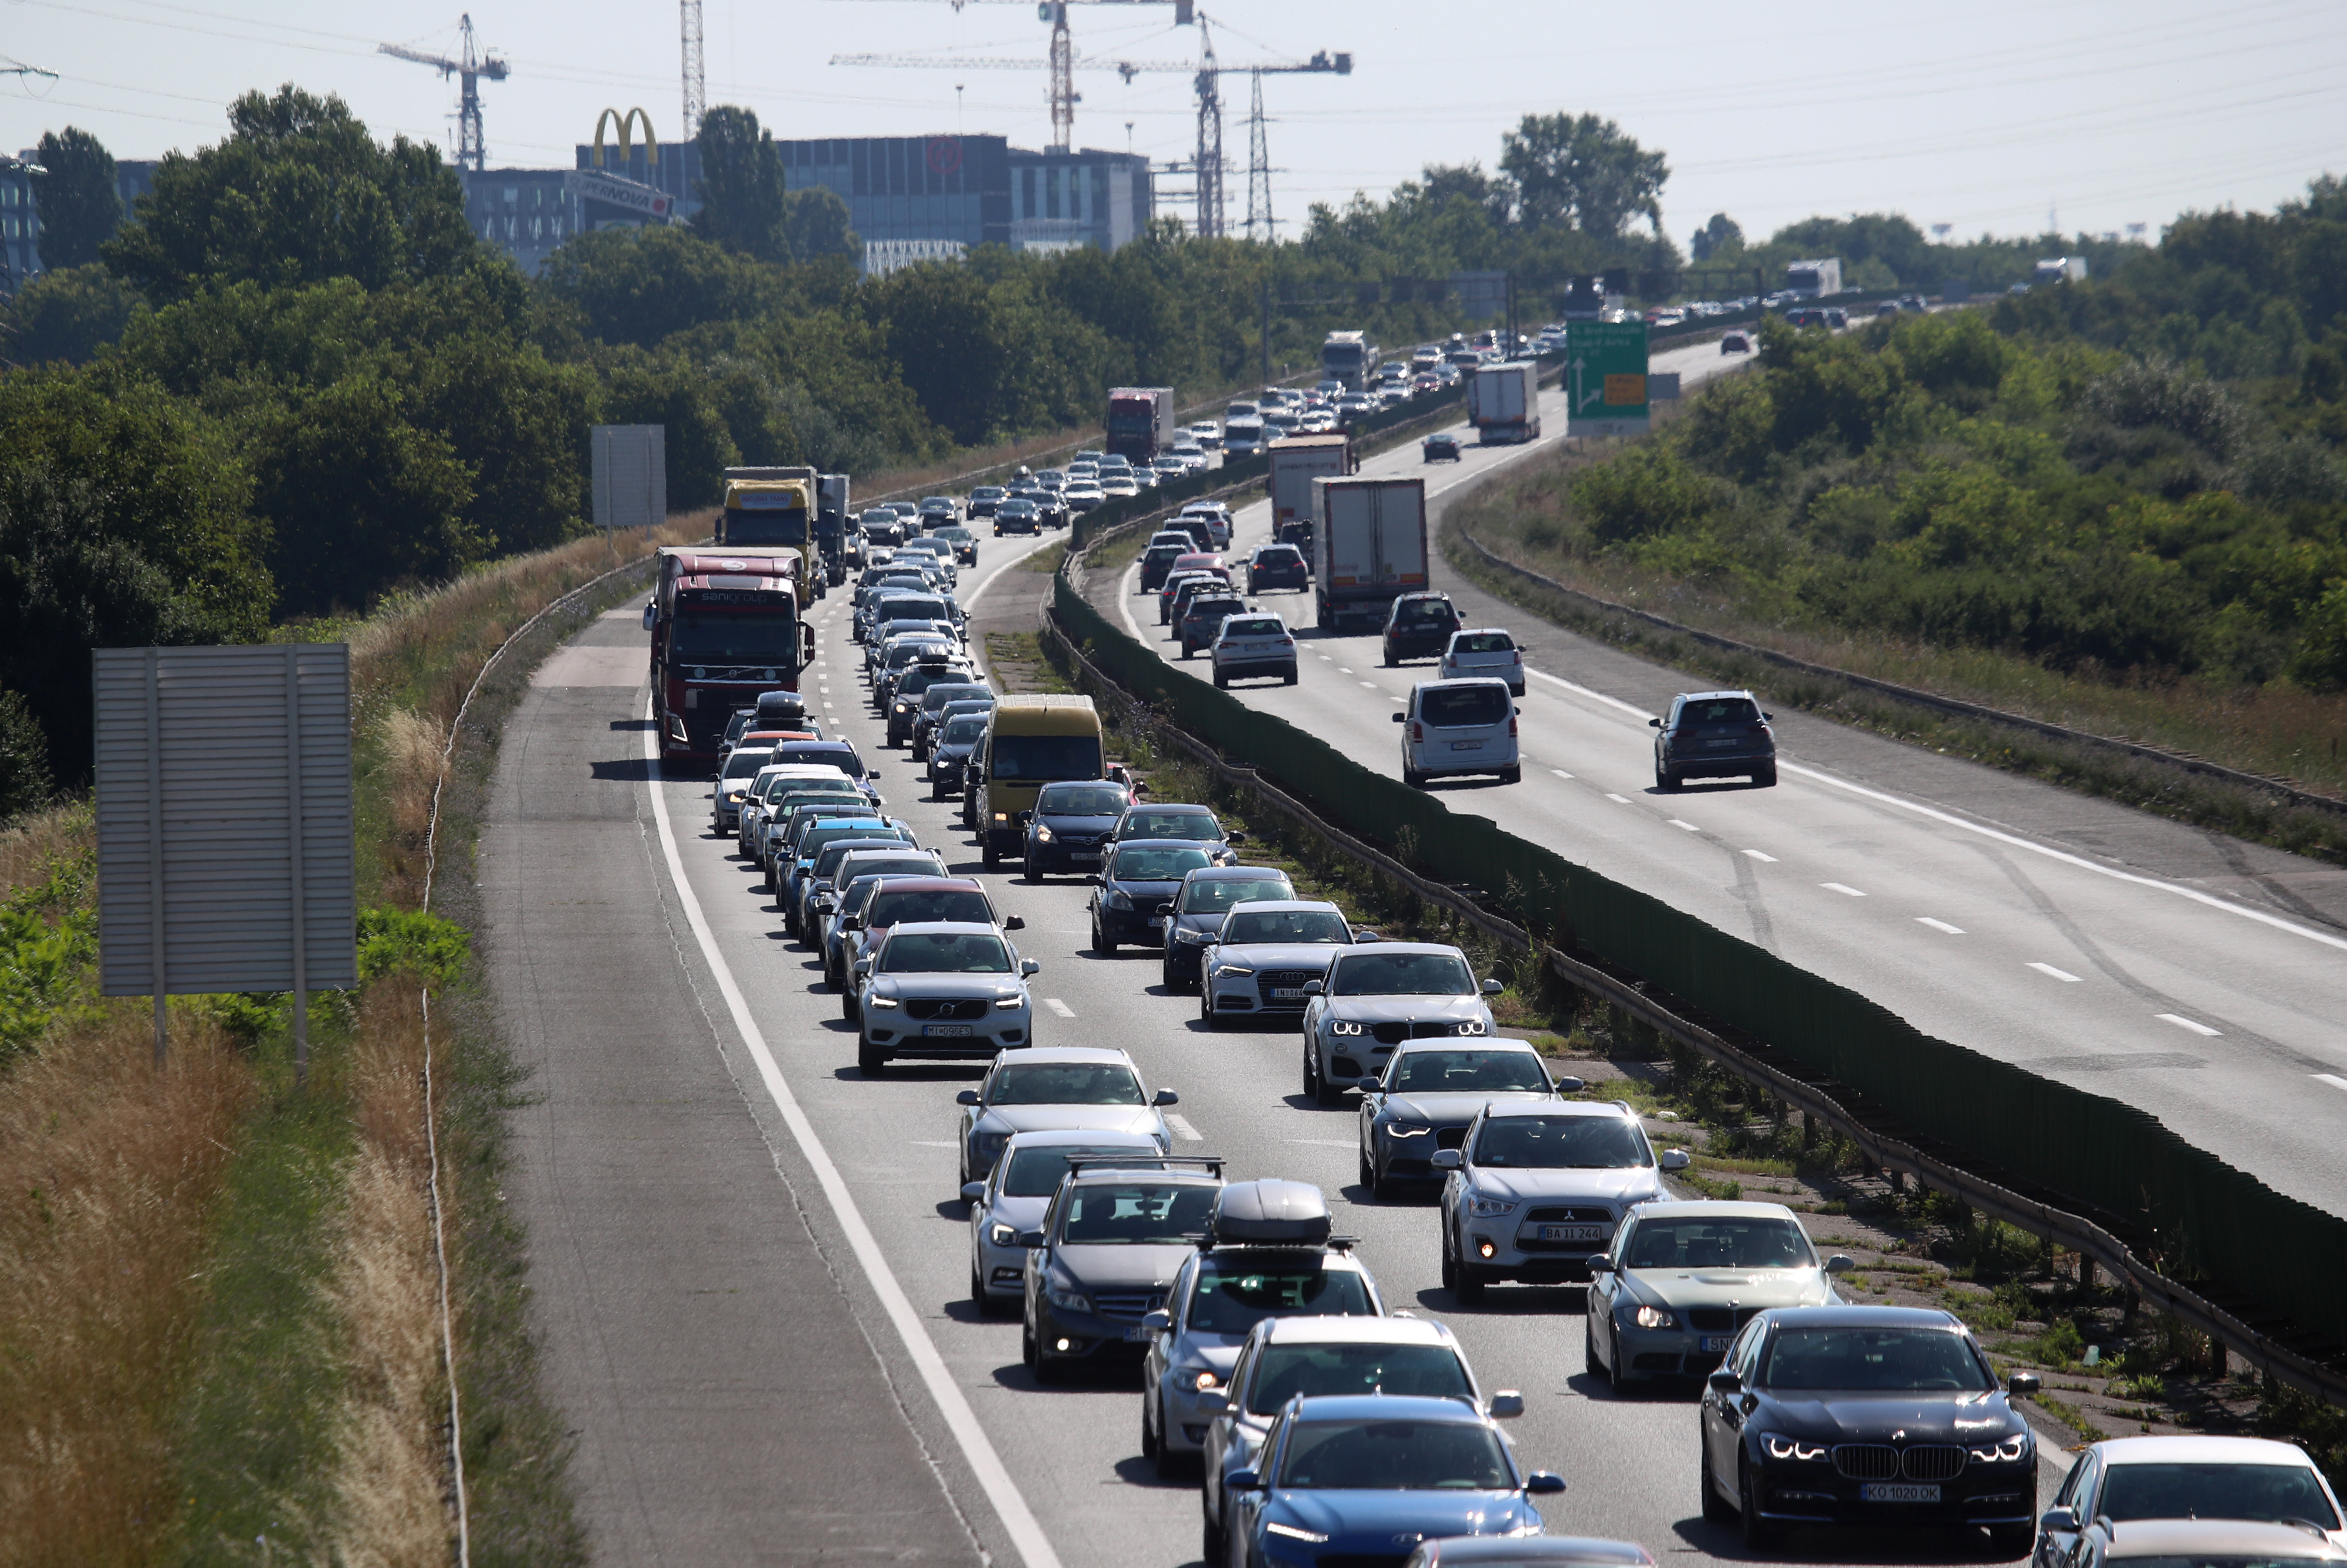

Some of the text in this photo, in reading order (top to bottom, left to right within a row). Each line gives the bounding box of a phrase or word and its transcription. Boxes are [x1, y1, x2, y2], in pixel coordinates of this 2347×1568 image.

[702, 593, 766, 605] sanigroup
[1547, 1228, 1599, 1238] BA 11 244
[1868, 1486, 1939, 1500] KO 1020 OK
